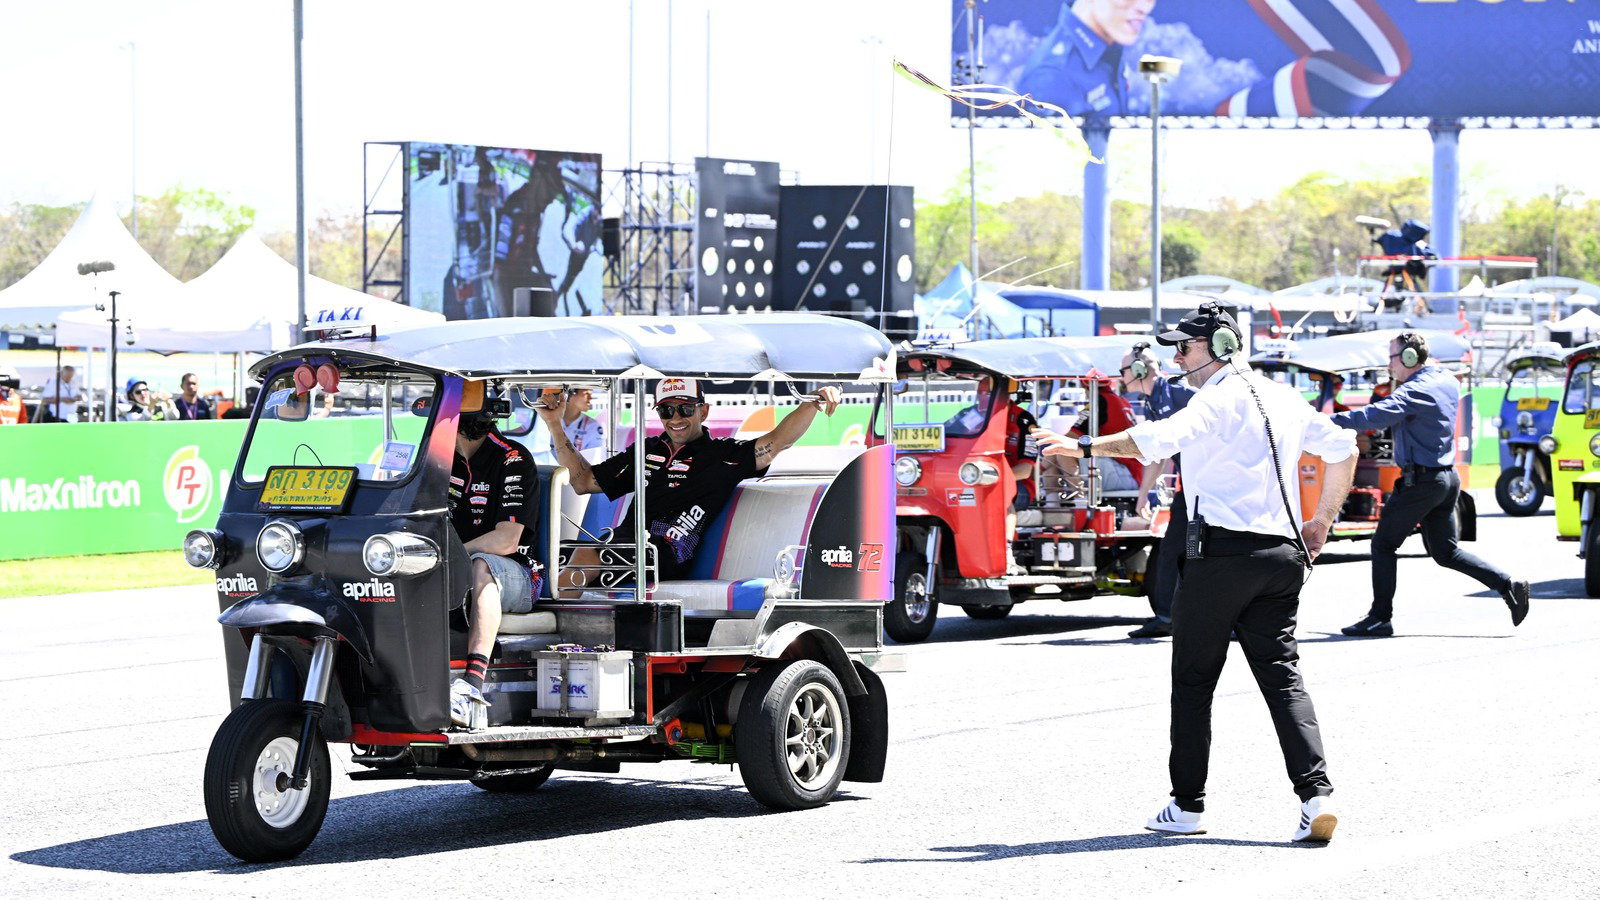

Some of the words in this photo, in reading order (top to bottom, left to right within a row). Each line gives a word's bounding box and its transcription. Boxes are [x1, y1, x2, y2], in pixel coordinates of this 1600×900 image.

[317, 306, 363, 323] TAXI
[662, 384, 673, 393] Red
[912, 427, 940, 440] 3140
[302, 470, 350, 490] 3199
[0, 475, 141, 512] Maxnitron
[821, 545, 853, 565] aprilia
[857, 543, 884, 572] 72
[216, 573, 258, 595] aprilia
[342, 577, 395, 600] aprilia
